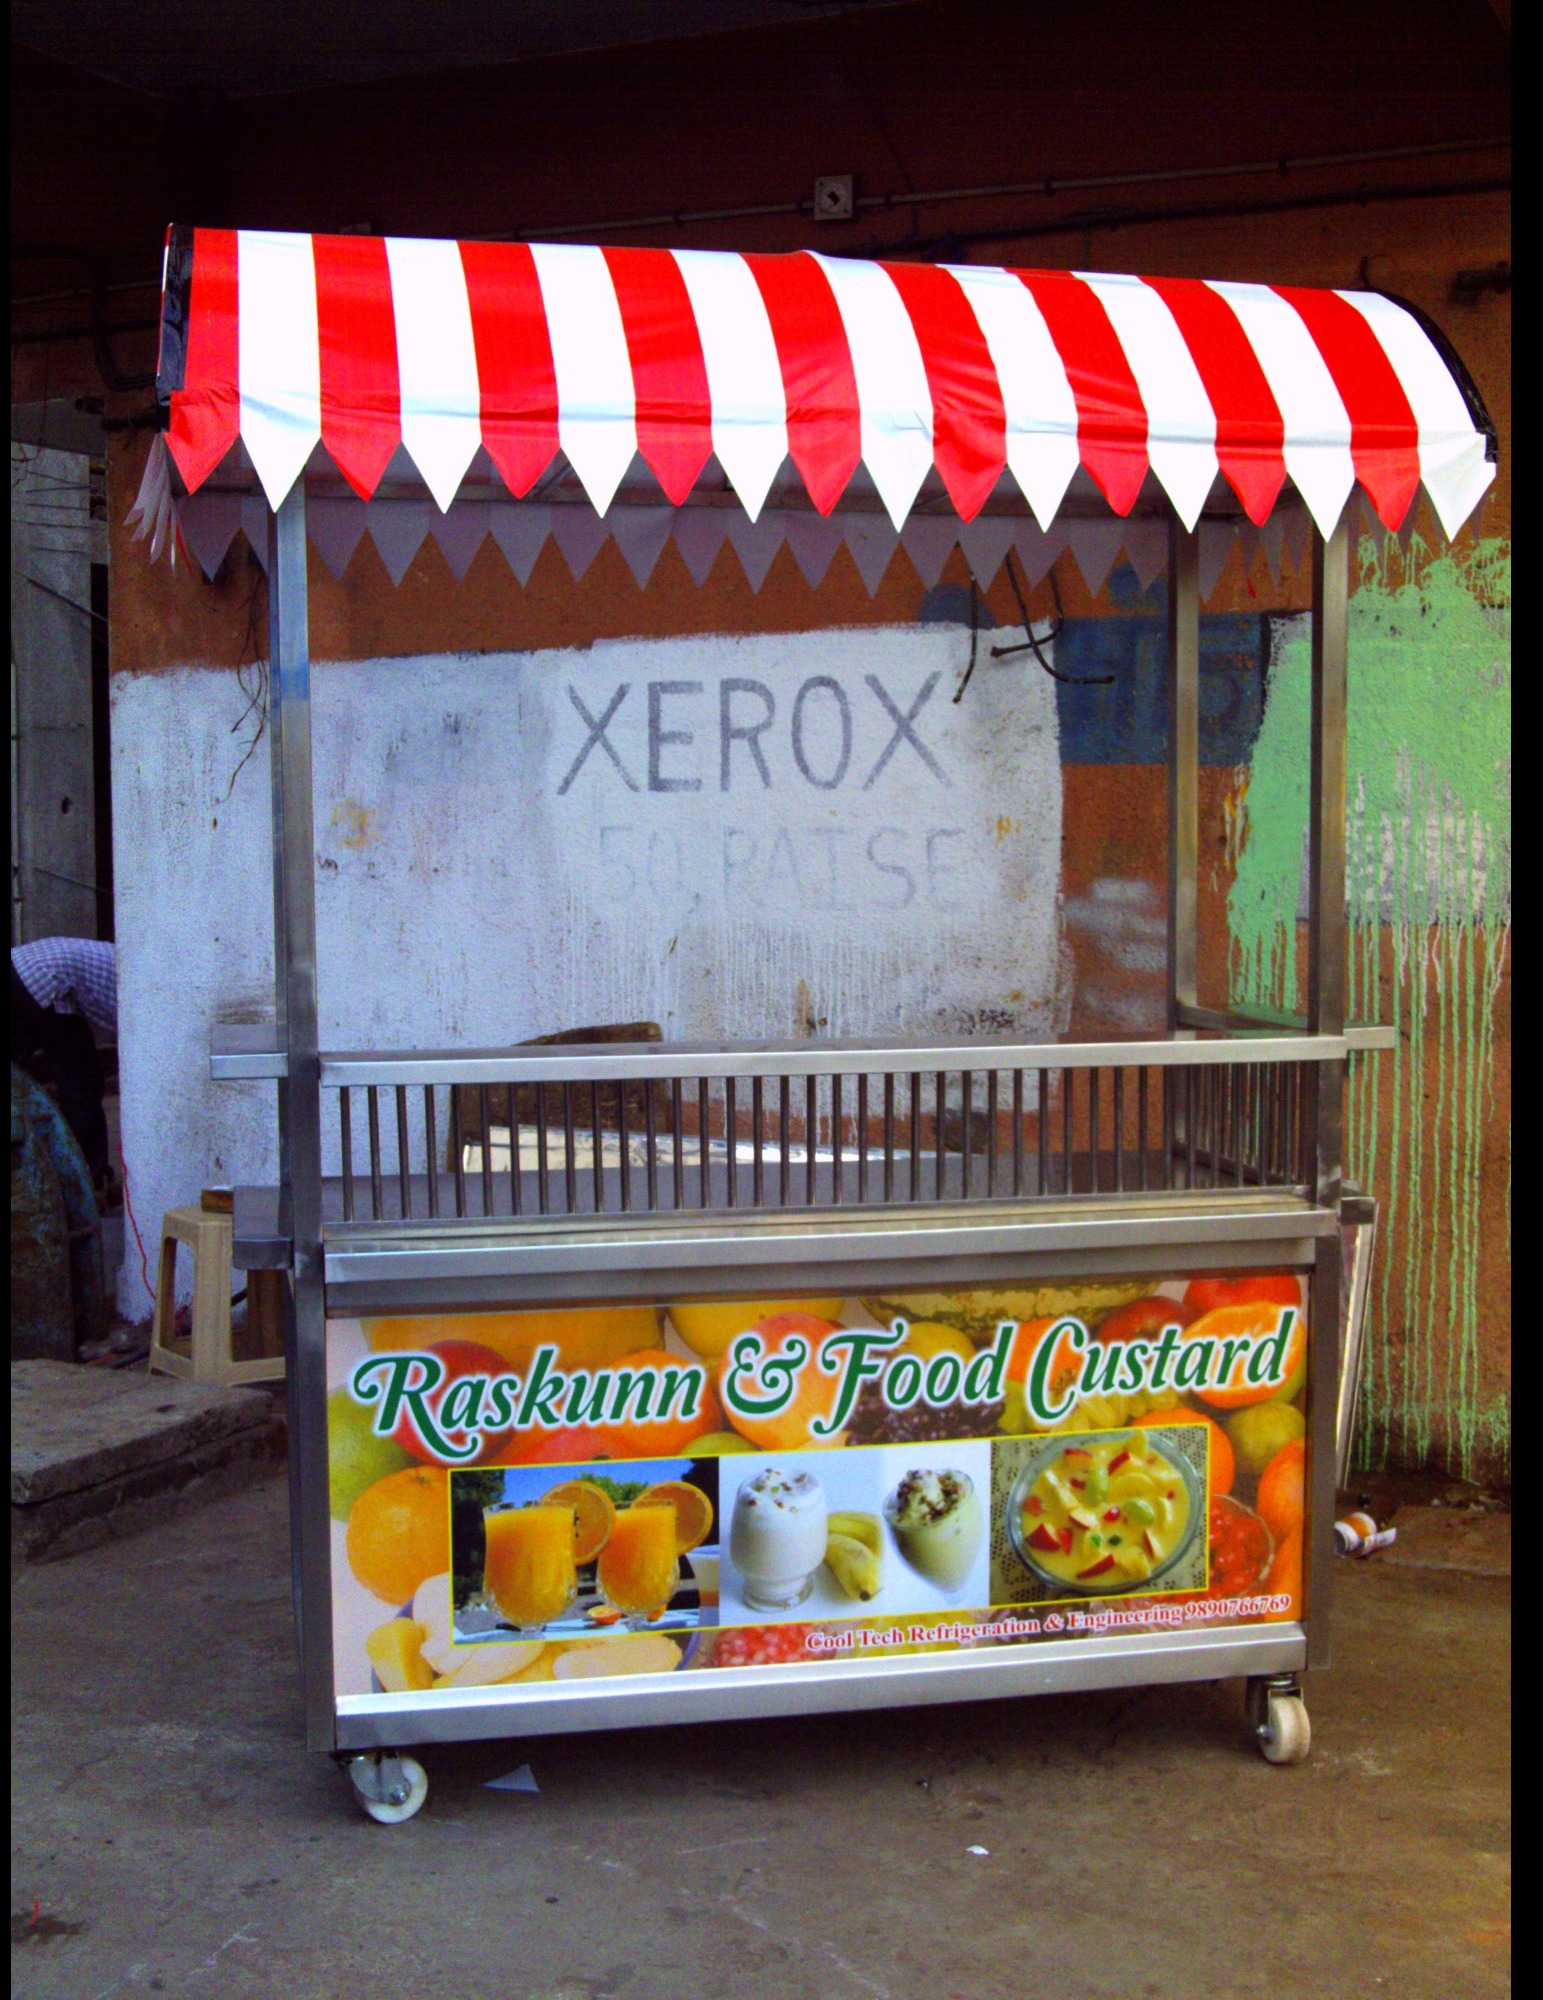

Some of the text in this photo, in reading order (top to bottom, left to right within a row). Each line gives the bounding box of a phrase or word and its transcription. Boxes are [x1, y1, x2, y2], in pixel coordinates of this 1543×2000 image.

[557, 671, 953, 794] XEROX
[354, 1310, 1294, 1458] Raskunn & Food Custard
[807, 1595, 1291, 1650] Cool Tech Refrigeration & Engineering 9890766769
